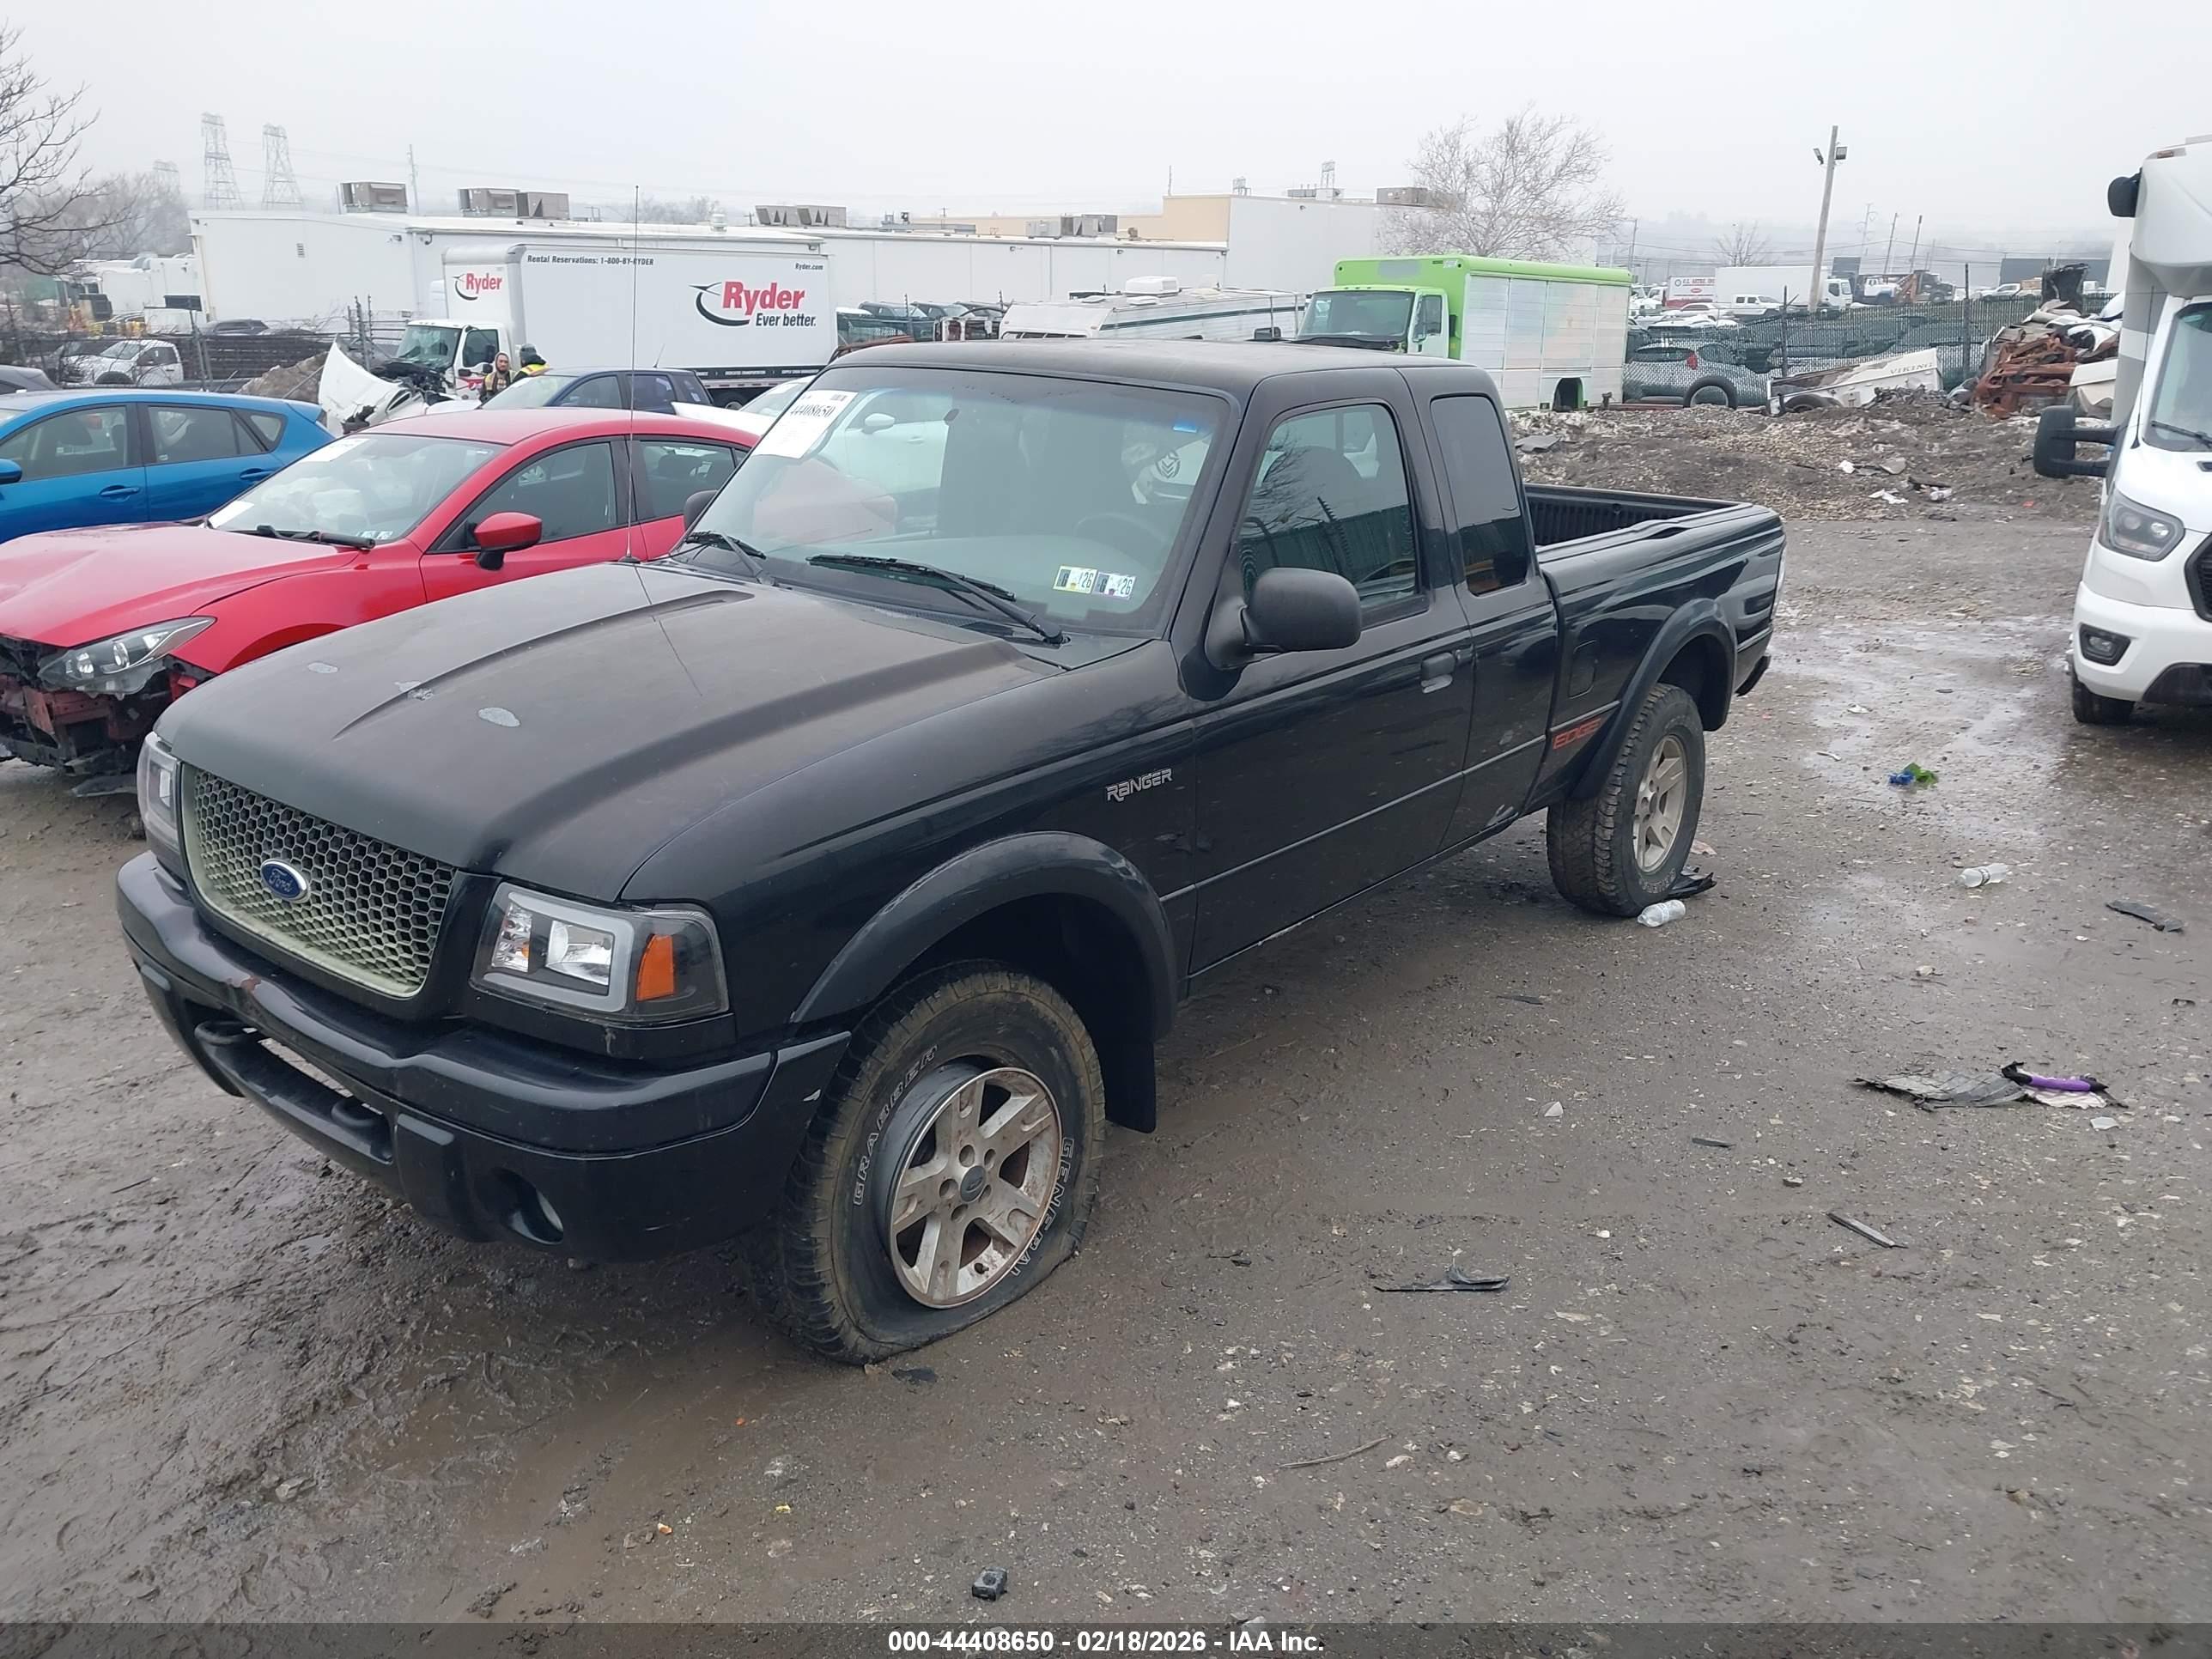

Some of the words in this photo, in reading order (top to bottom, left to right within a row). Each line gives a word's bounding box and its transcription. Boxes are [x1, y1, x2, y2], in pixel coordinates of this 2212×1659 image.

[551, 256, 599, 264] Reservations:
[465, 272, 502, 295] Ryder
[722, 281, 805, 316] Ryder
[755, 313, 781, 327] Ever
[782, 313, 817, 327] better.
[854, 1045, 938, 1206] GRABBER
